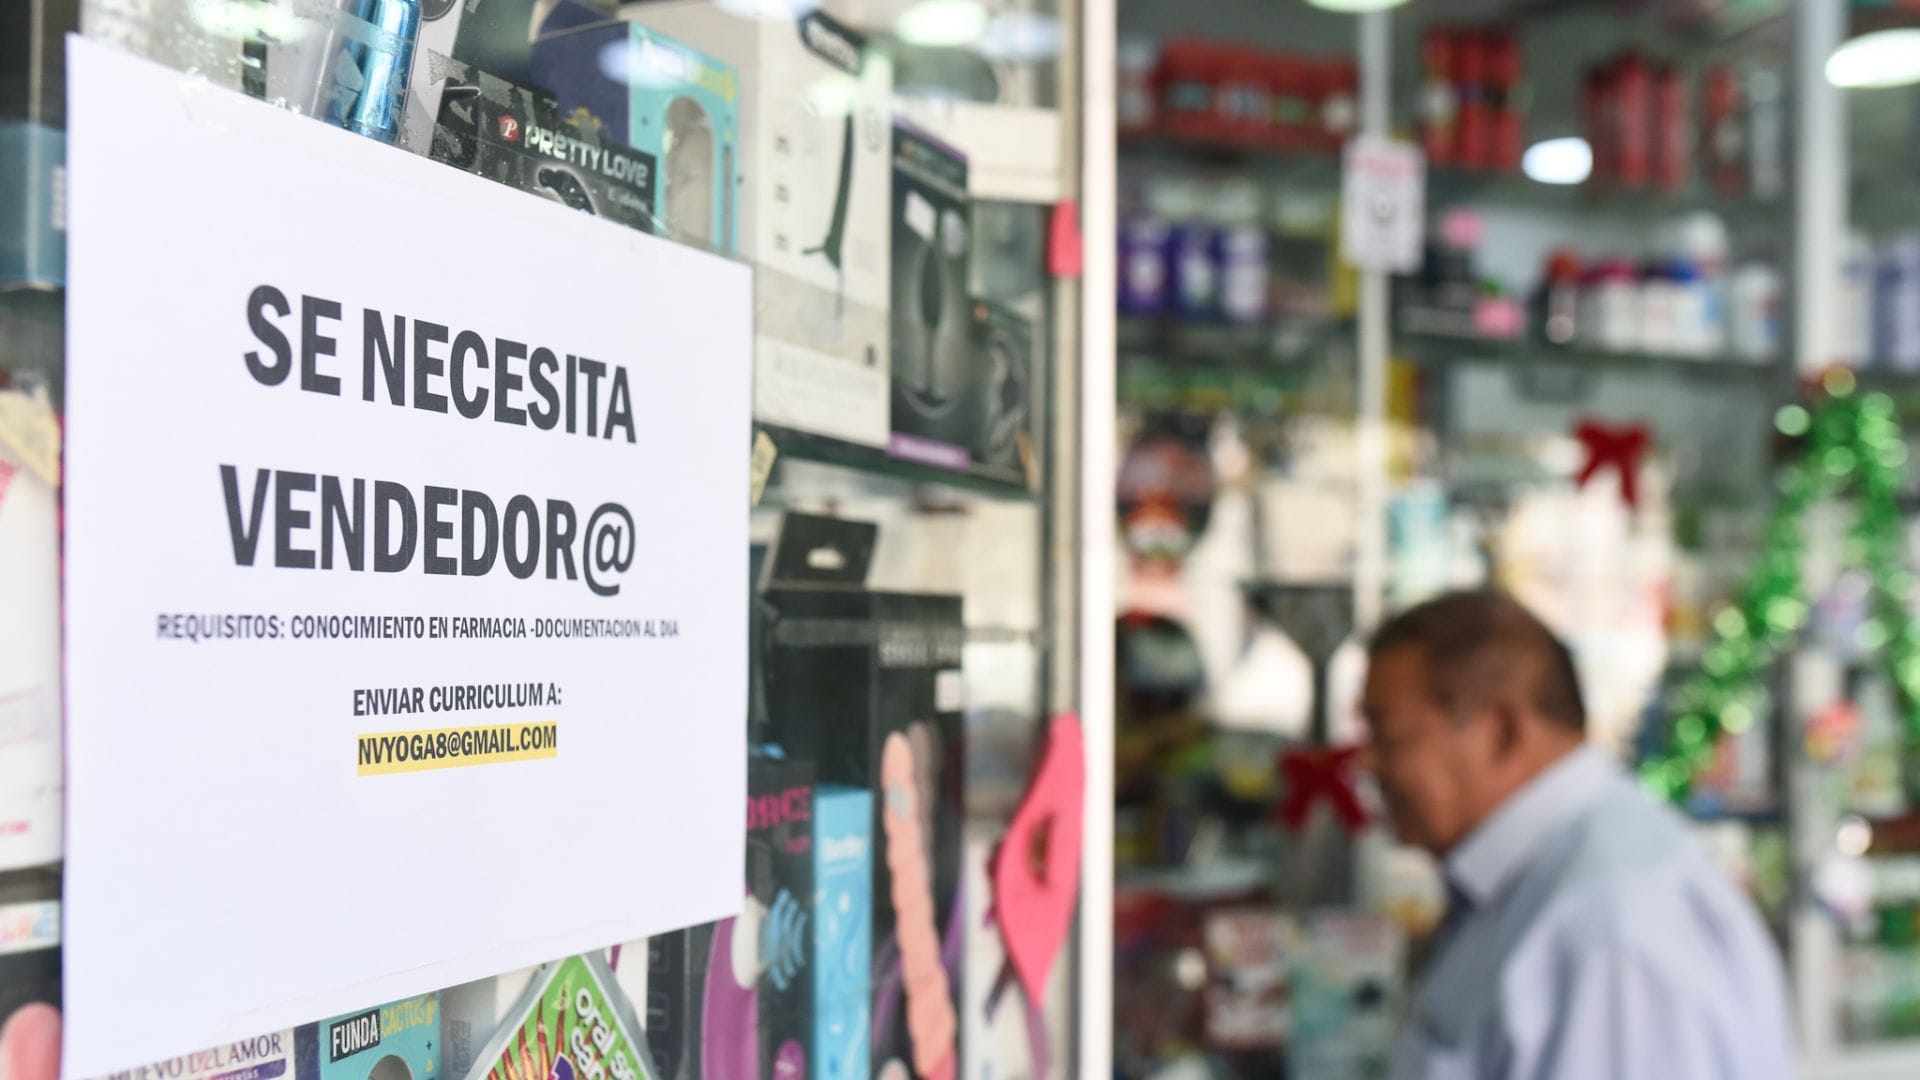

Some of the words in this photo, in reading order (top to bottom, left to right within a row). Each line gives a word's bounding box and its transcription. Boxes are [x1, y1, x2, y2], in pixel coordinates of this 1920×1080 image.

[243, 284, 342, 397] SE
[362, 307, 636, 443] NECESITA
[219, 464, 636, 597] VENDEDOR@
[156, 613, 286, 643] REQUISITOS:
[291, 614, 425, 639] CONOCIMIENTO
[429, 616, 448, 639] EN
[452, 616, 527, 639] FARMACIA
[530, 617, 641, 639] -DOCUMENTACION
[644, 618, 657, 638] AL
[660, 618, 680, 638] DIA
[353, 687, 425, 716] ENVIAR
[429, 683, 543, 712] CURRICULUM
[546, 682, 562, 705] A:
[358, 725, 557, 766] NVYOGA8@GMAIL.COM
[228, 1032, 282, 1064] AMOR
[332, 1013, 379, 1058] FUNDA
[381, 999, 426, 1038] CACTUS
